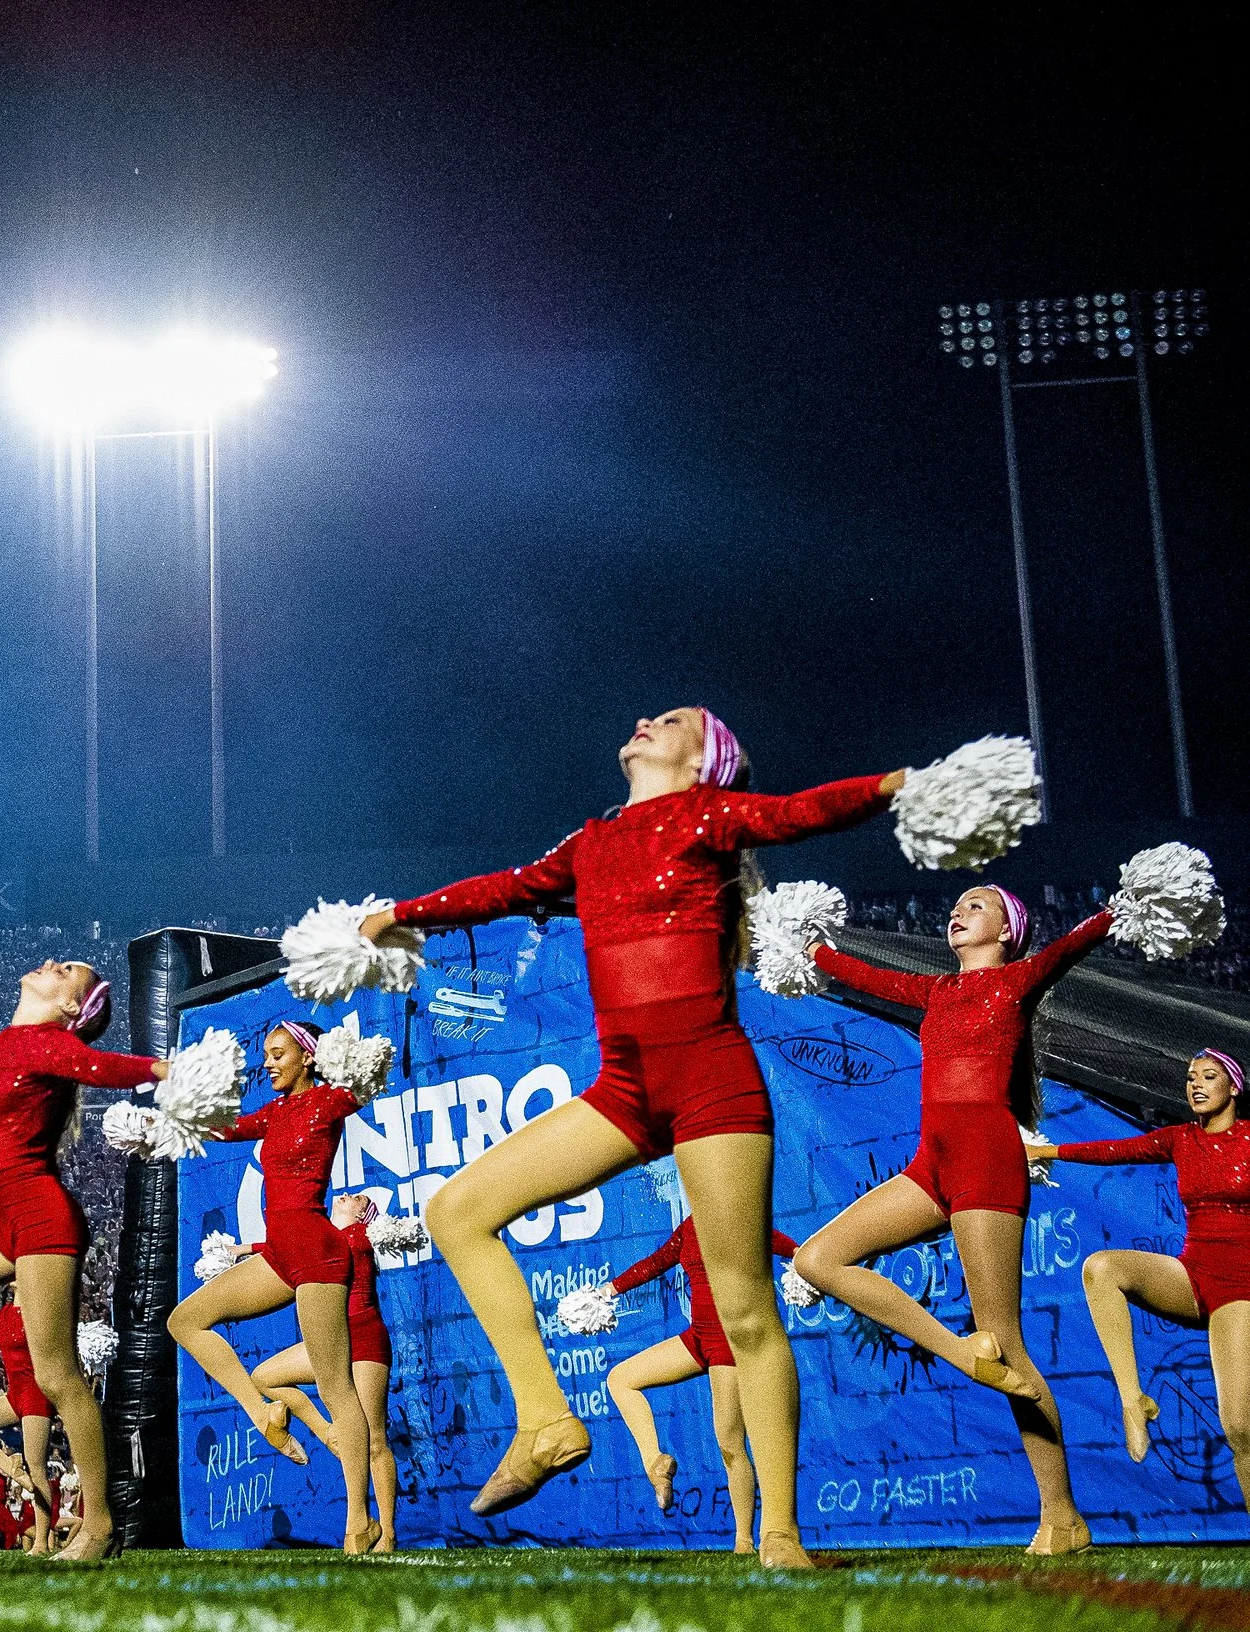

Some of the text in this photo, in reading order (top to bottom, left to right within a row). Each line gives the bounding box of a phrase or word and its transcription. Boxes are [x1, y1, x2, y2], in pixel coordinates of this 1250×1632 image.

[432, 1018, 494, 1042] BREAK IT
[791, 1039, 874, 1082] UNKNOWN
[206, 1425, 258, 1483] RULE
[209, 1467, 274, 1531] LAND!
[816, 1466, 978, 1513] GO FASTER
